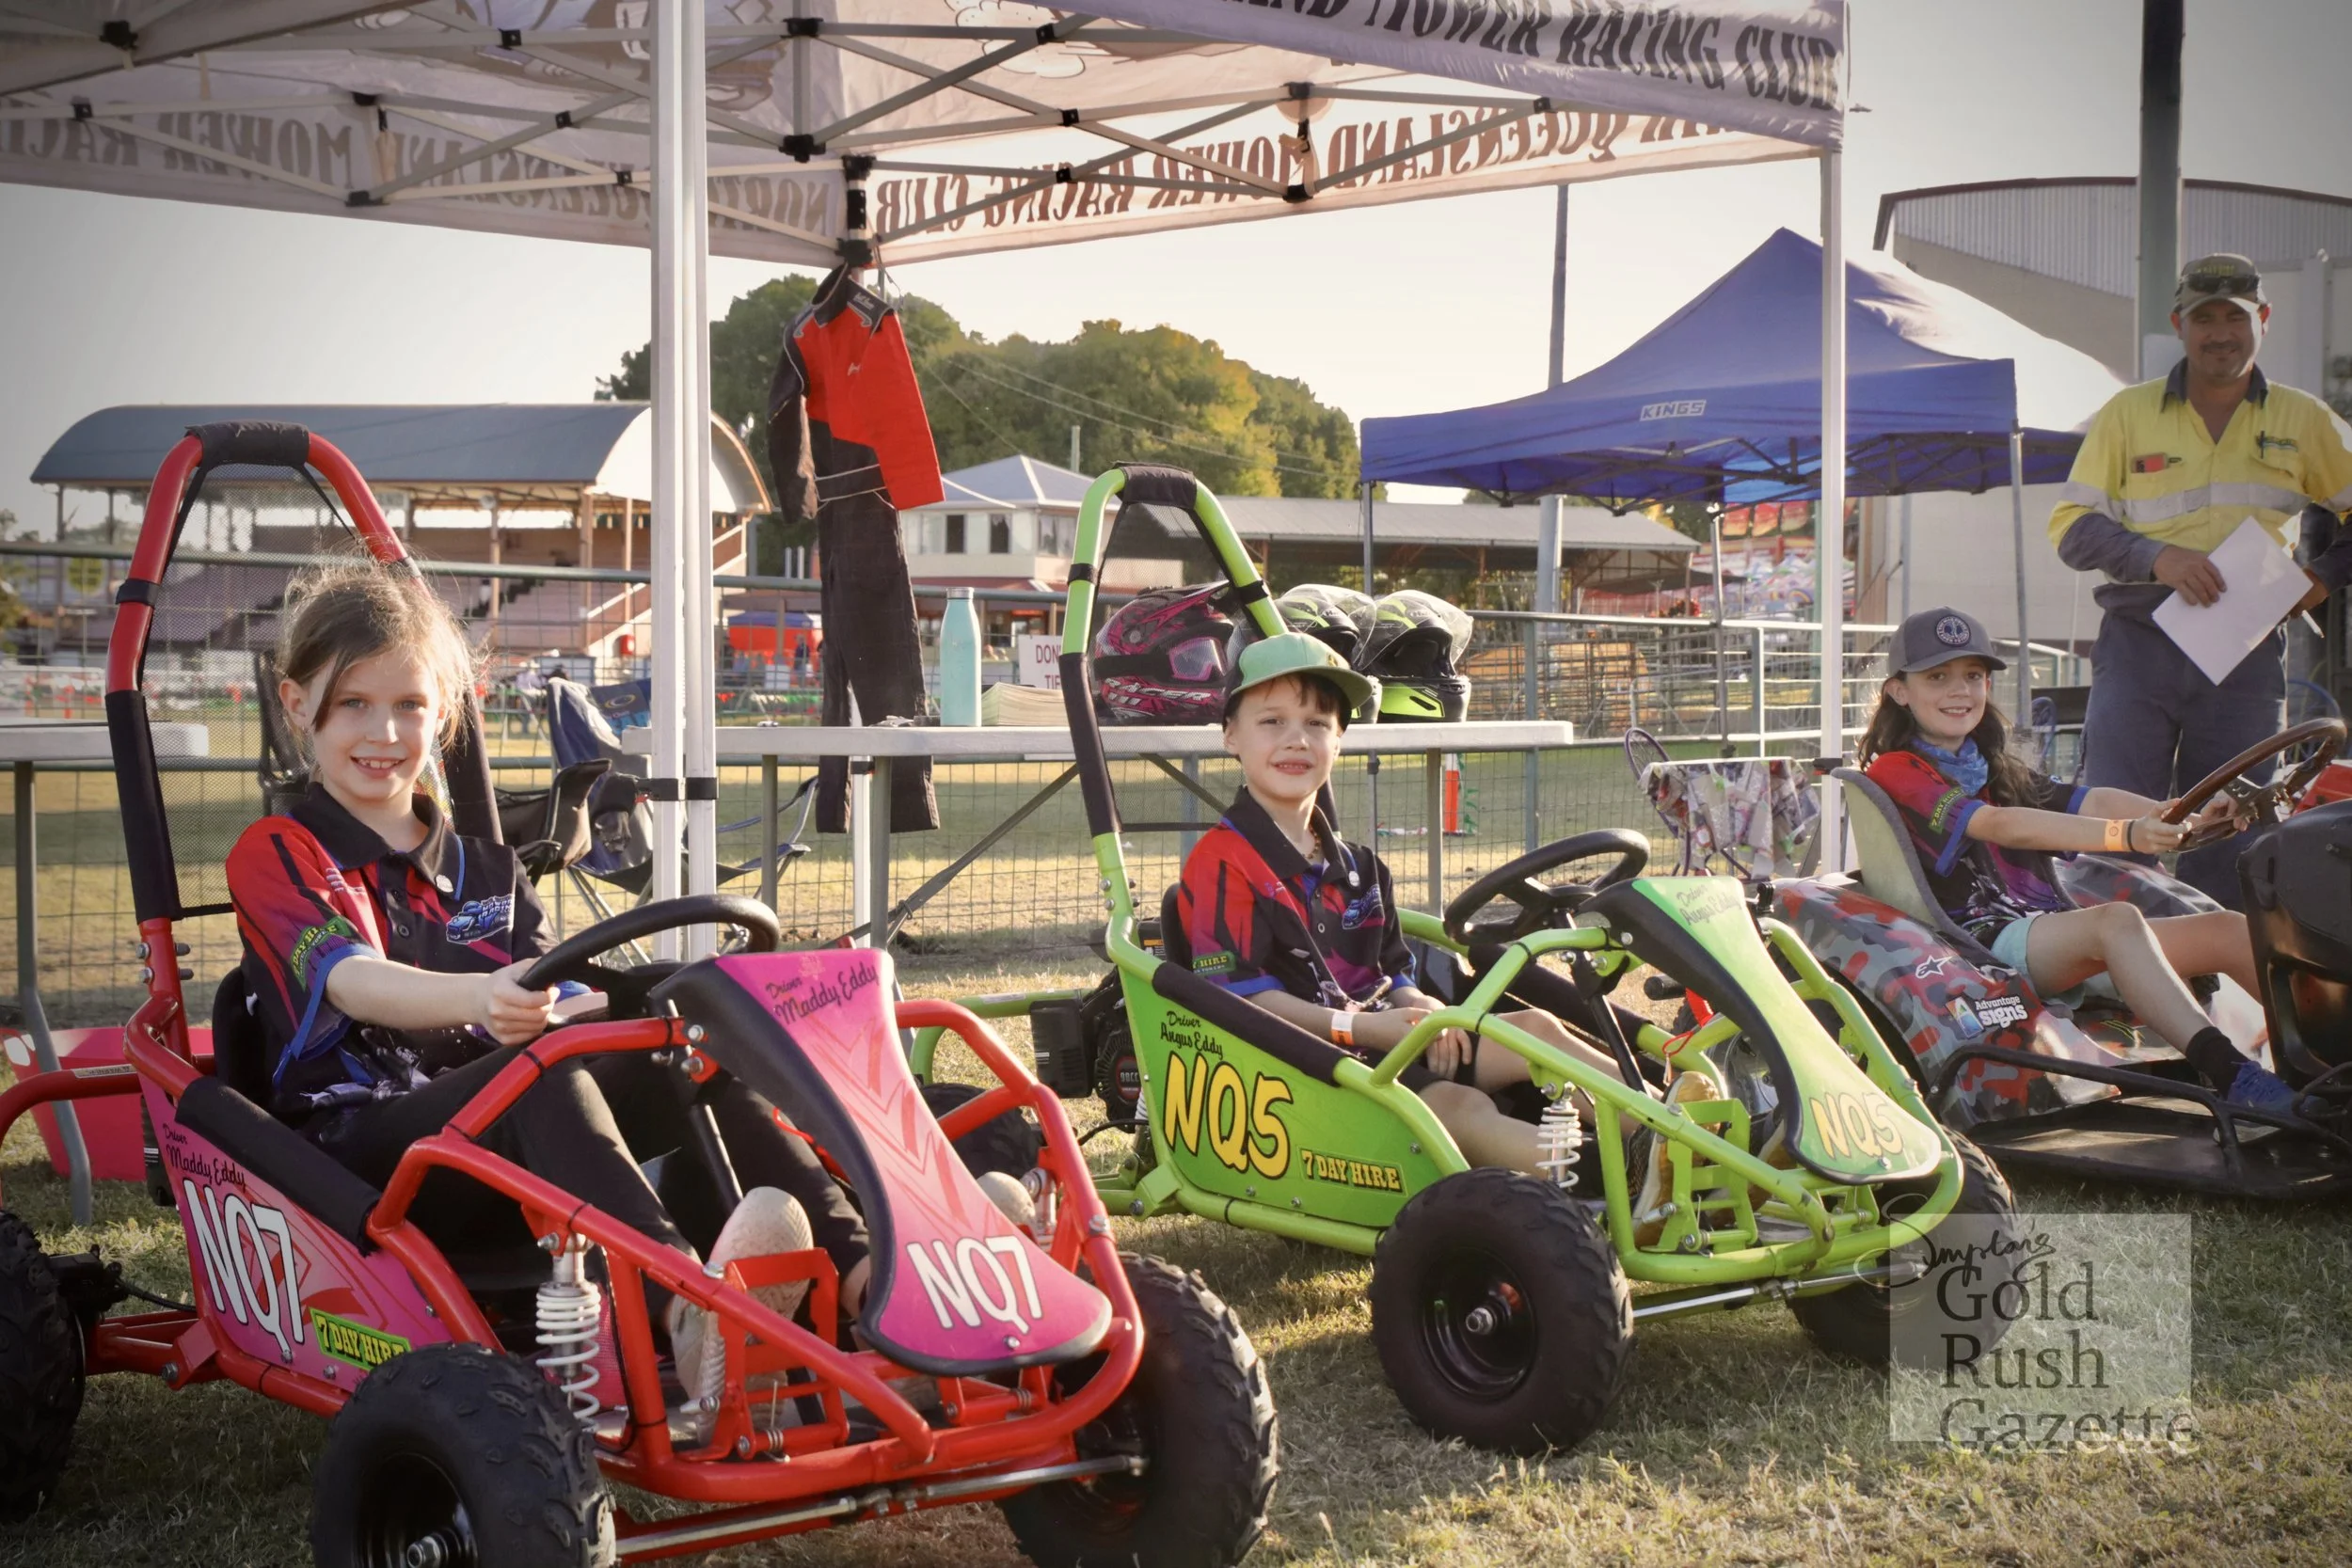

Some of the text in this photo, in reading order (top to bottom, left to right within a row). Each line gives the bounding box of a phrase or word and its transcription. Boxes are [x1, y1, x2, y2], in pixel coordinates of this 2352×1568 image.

[1556, 5, 1725, 90] RACING
[1735, 24, 1839, 111] CLUB
[1642, 402, 1704, 420] KINGS
[304, 924, 337, 943] HIE
[765, 976, 803, 1000] Driver
[774, 960, 881, 1025] Maddy Eddy
[1975, 996, 2021, 1011] Advantage
[1167, 1010, 1201, 1027] Driver
[1978, 1005, 2028, 1028] signs
[1160, 1022, 1223, 1060] Angus Eddy
[163, 1122, 188, 1145] Driver
[1163, 1050, 1294, 1180] NQ5
[1809, 1091, 1904, 1161] NQ5
[166, 1144, 246, 1194] Maddy Eddy
[1300, 1148, 1403, 1193] 7 DAY HIRE
[183, 1178, 305, 1357] NQ7
[906, 1234, 1043, 1336] NQ7
[315, 1314, 332, 1353] 7
[327, 1321, 363, 1363] DAY
